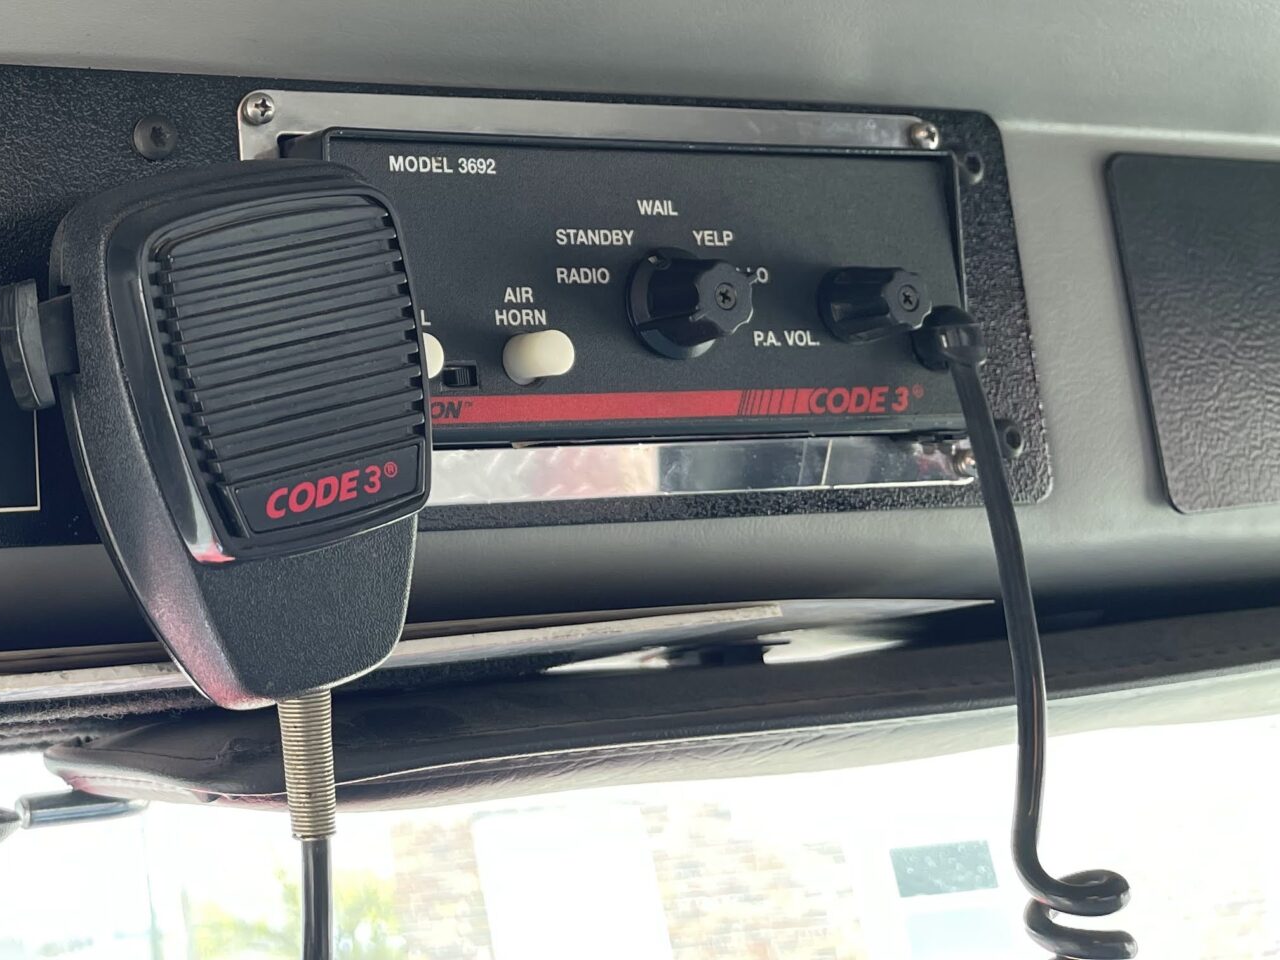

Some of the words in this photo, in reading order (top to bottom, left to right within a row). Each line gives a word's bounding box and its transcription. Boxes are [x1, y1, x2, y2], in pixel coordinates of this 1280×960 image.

[388, 155, 453, 174] MODEL
[458, 157, 497, 175] 3692
[636, 199, 679, 217] WAIL
[555, 228, 634, 246] STANDBY
[692, 229, 734, 246] YELP
[556, 267, 610, 284] RADIO
[503, 286, 534, 304] AIR
[494, 309, 547, 326] HORN
[753, 330, 781, 347] P.A.
[784, 330, 821, 347] VOL.
[809, 386, 889, 414] CODE
[265, 469, 361, 520] CODE
